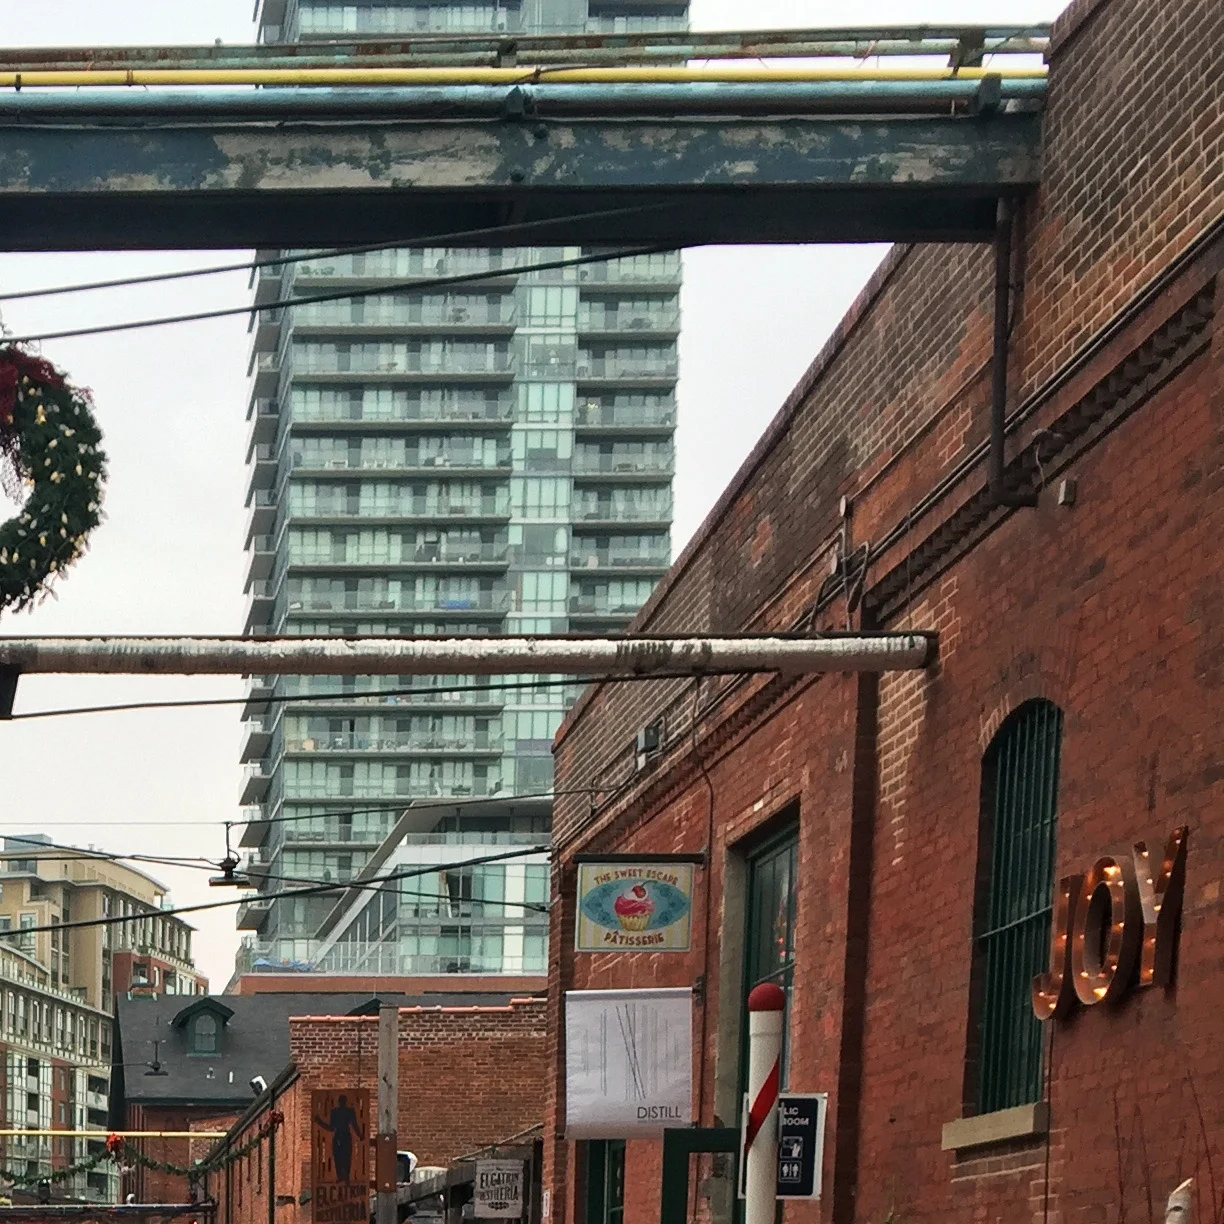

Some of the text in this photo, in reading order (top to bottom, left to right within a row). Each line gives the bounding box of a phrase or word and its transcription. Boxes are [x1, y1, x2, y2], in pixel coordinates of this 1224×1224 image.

[594, 868, 679, 886] THE SWEET ESCAPE
[1032, 826, 1188, 1020] JOY
[637, 1106, 682, 1119] DISTILL
